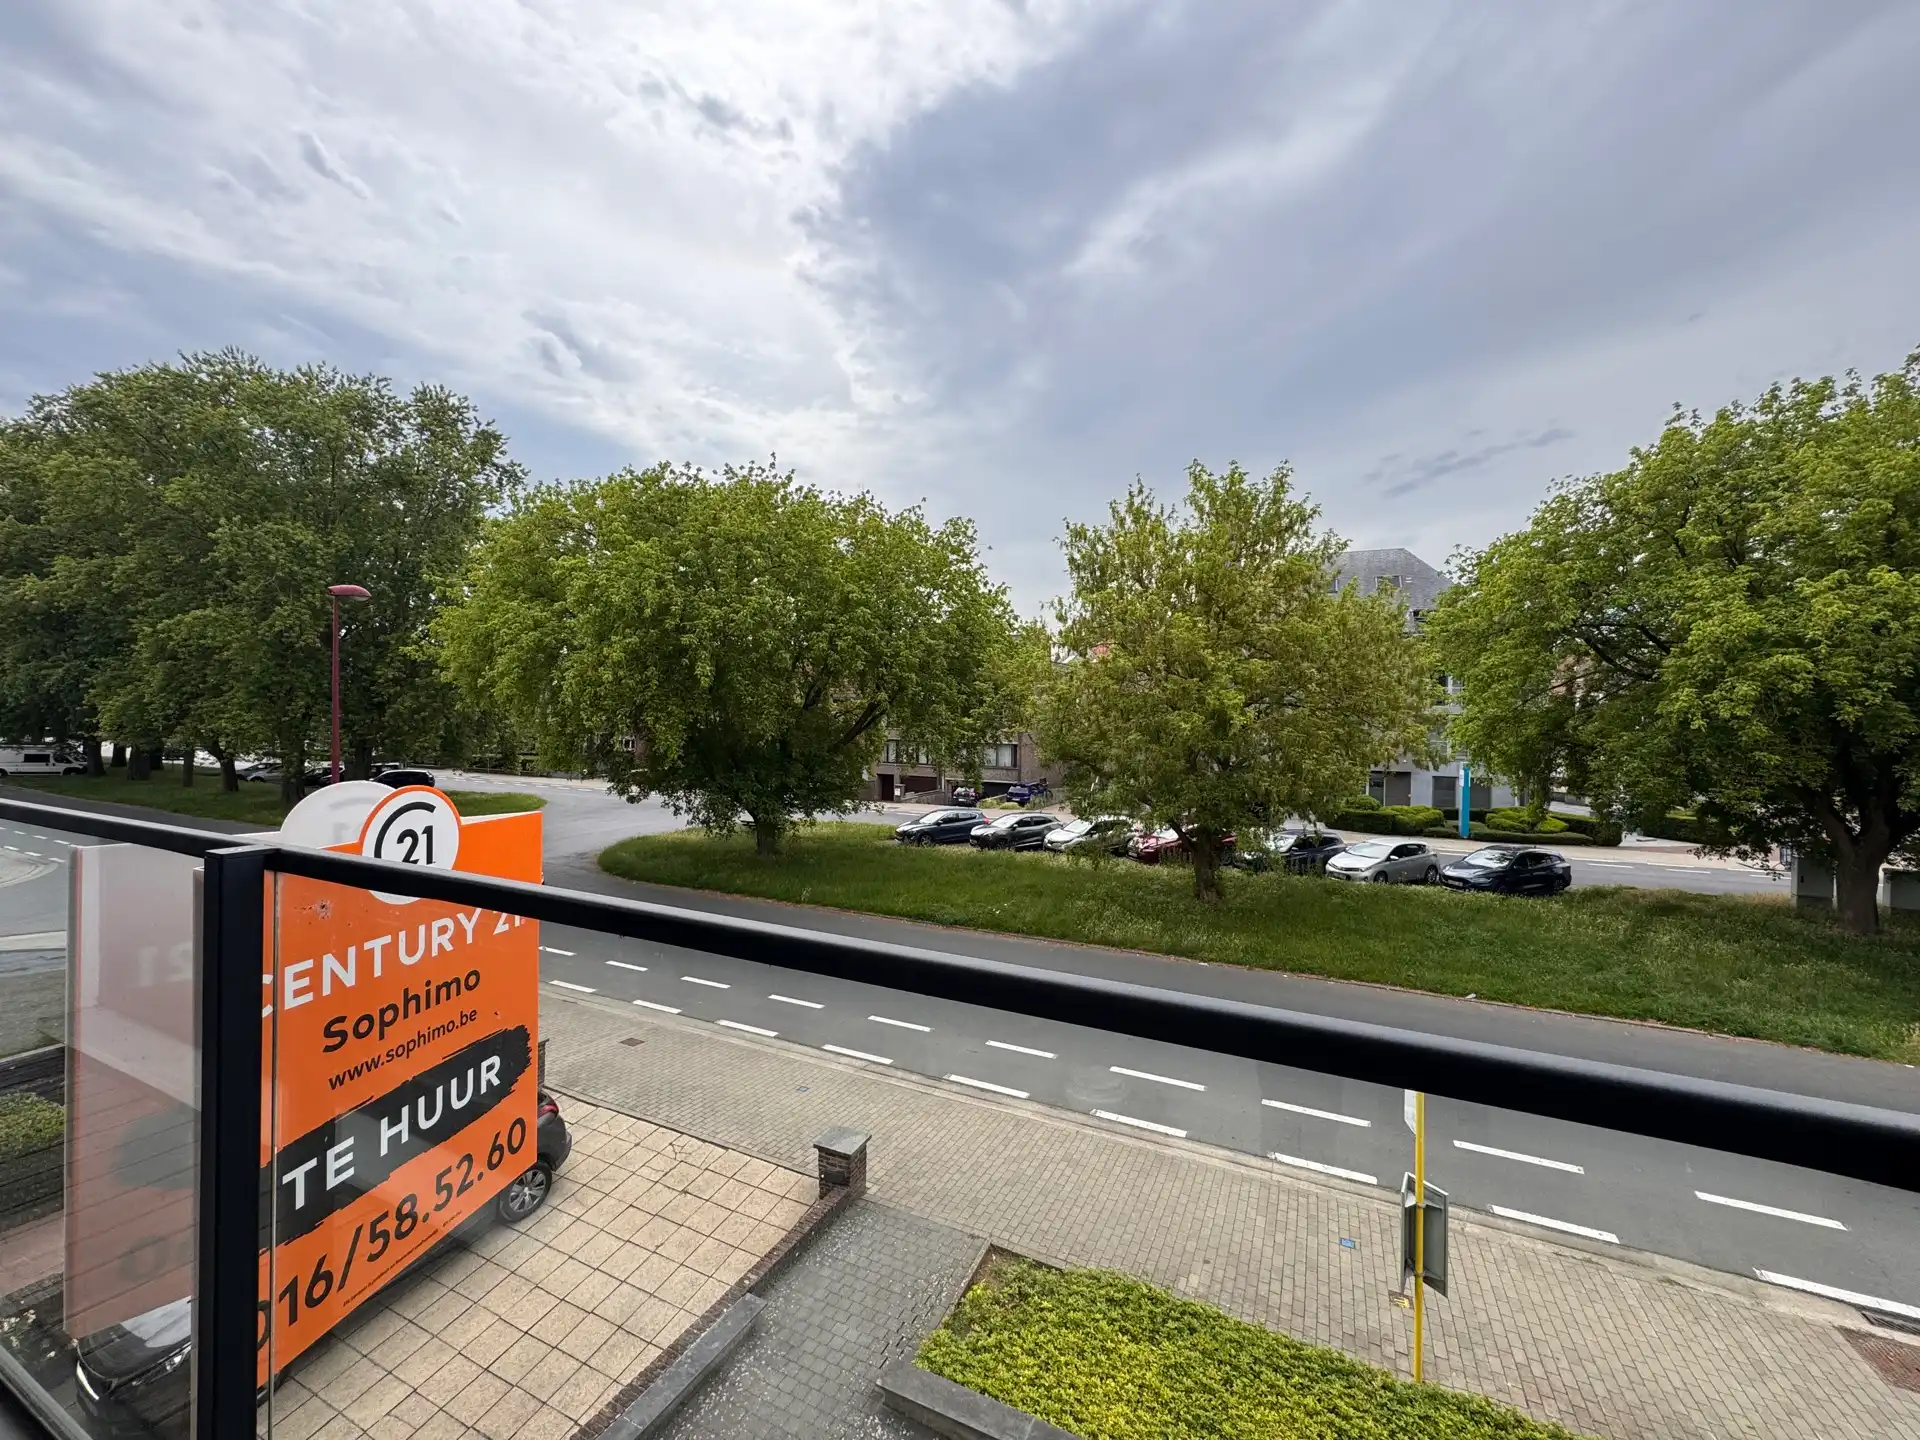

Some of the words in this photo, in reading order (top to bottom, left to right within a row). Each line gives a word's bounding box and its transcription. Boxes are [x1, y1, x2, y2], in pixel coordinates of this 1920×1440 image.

[322, 969, 481, 1054] Sophimo
[328, 1007, 478, 1091] www.sophimo.be
[282, 1136, 355, 1211] TE
[380, 1055, 501, 1157] HUUR
